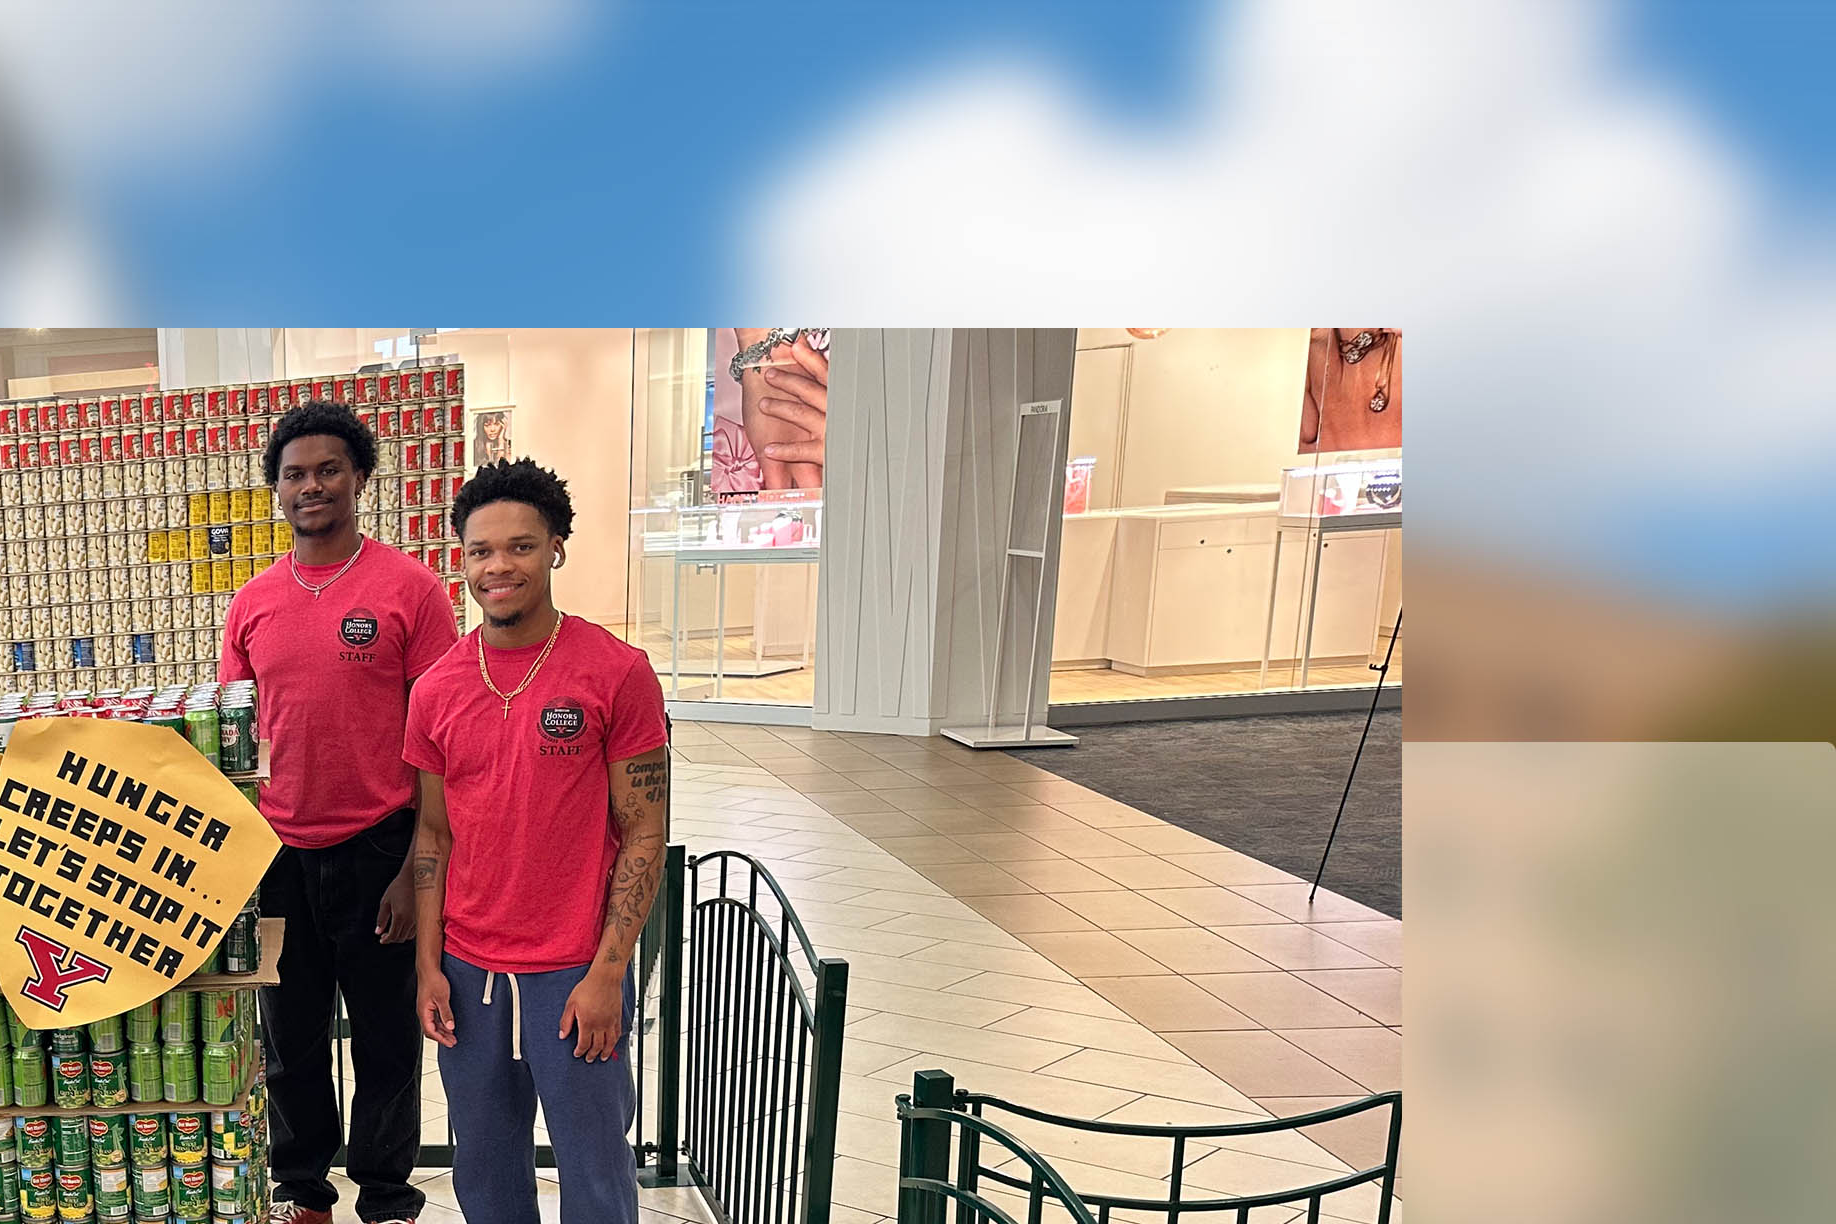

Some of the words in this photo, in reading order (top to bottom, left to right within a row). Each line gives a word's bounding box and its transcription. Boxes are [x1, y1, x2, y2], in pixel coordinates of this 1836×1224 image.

[339, 652, 376, 662] STAFF
[546, 712, 577, 720] HONORS
[539, 745, 583, 756] STAFF
[57, 751, 231, 852] HUNGER
[86, 863, 184, 924] STOP
[181, 912, 223, 949] IT
[14, 924, 112, 1013] Y
